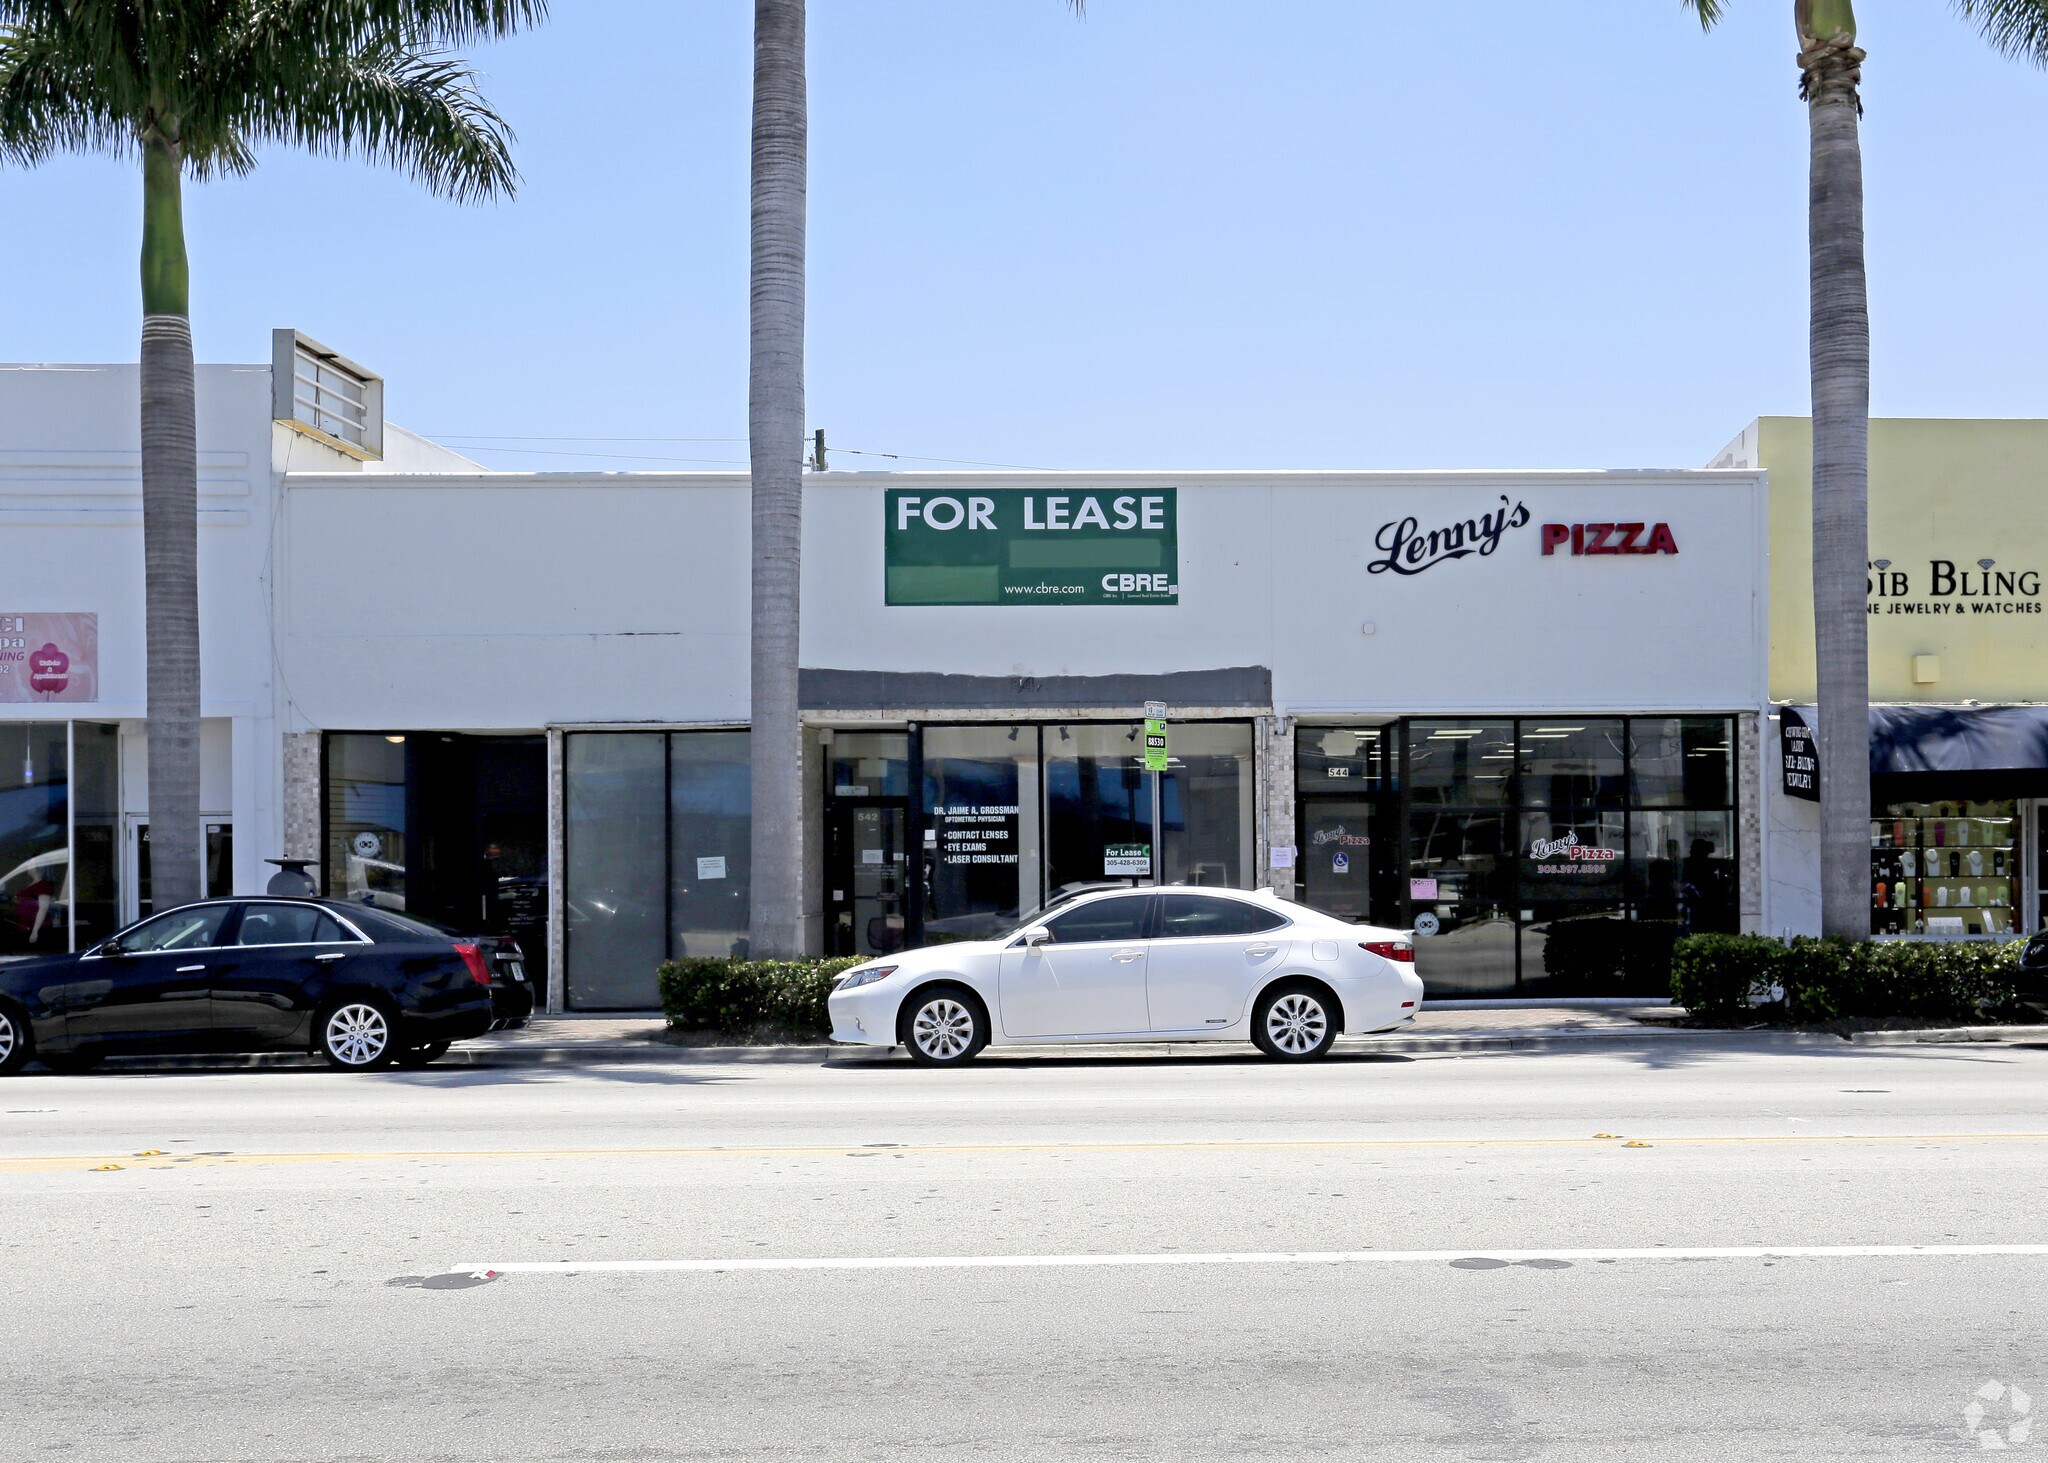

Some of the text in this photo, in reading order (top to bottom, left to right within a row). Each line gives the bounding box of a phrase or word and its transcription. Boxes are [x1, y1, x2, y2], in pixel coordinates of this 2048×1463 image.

[898, 496, 1164, 531] FOR LEASE
[1366, 494, 1531, 576] Lenny's
[1540, 522, 1680, 556] PIZZA
[1004, 581, 1085, 595] www.cbre.com
[1101, 573, 1168, 592] CBRE
[1887, 603, 1950, 614] JEWELRY
[1955, 603, 1965, 614] &
[1971, 602, 2042, 614] WATCHES
[1329, 768, 1348, 777] 544
[934, 806, 1019, 815] DR. JAIME A. GROSSMAN
[858, 813, 878, 821] 542
[947, 831, 1008, 839] CONTACT LENSES
[1340, 835, 1370, 845] Pizza
[947, 843, 987, 851] EYE EXAMS
[1530, 830, 1578, 859] Lenny's
[947, 855, 1018, 863] LASER CONSULTANT
[1570, 846, 1614, 860] Pizza
